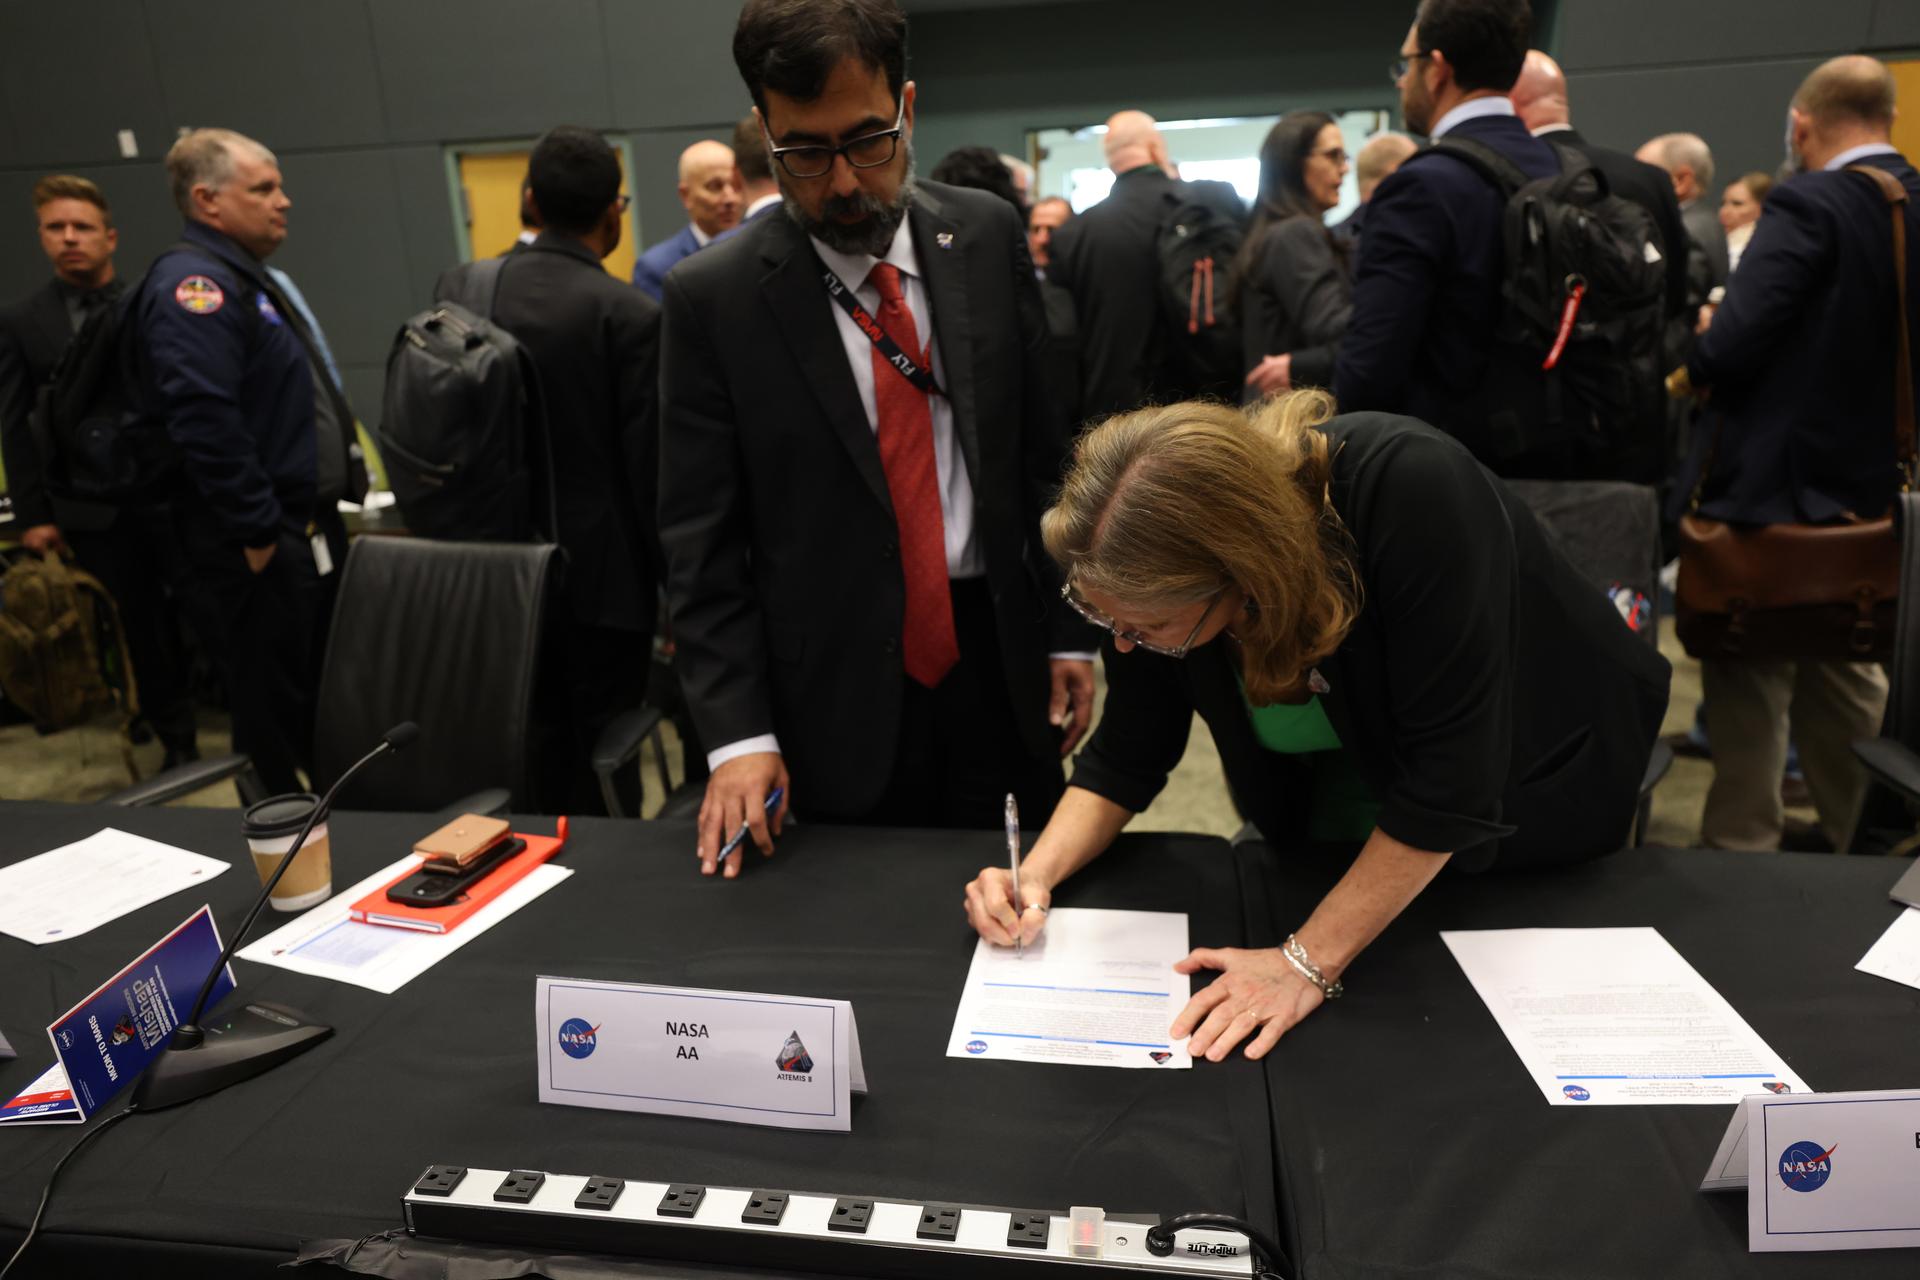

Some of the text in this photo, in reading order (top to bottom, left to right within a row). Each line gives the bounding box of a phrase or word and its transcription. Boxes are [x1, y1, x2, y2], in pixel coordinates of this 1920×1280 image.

[852, 305, 884, 342] NASA
[891, 353, 916, 376] FLY
[132, 979, 163, 1047] Mishap
[666, 1021, 709, 1038] NASA
[561, 1032, 595, 1045] NASA
[88, 1015, 118, 1081] MOON TO MARS
[676, 1045, 699, 1060] AA
[777, 1073, 806, 1082] ARTEMIS
[1783, 1161, 1828, 1173] NASA
